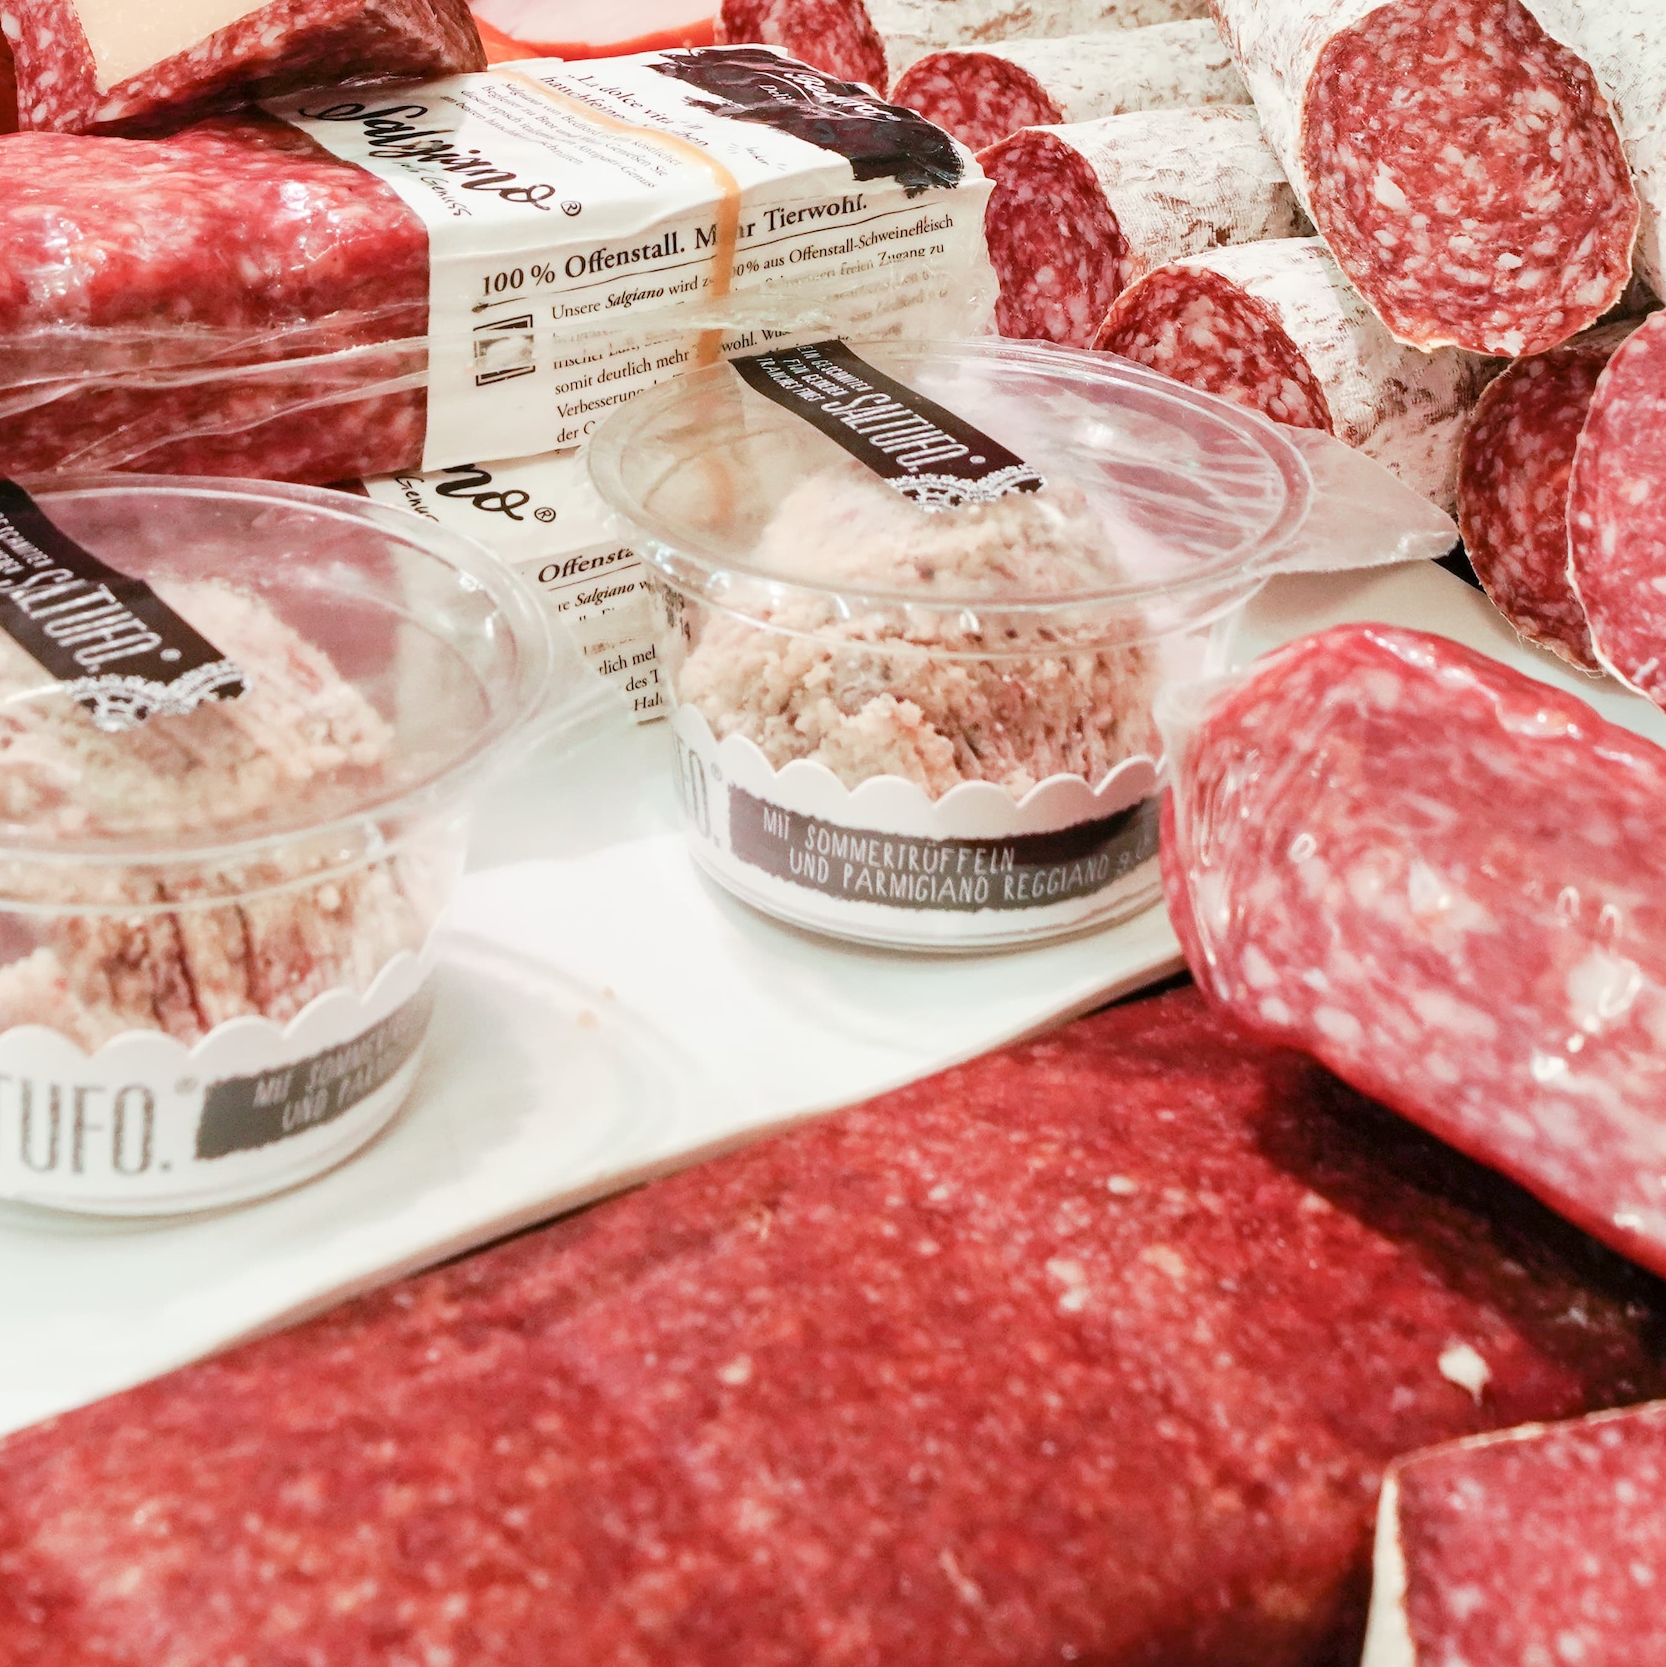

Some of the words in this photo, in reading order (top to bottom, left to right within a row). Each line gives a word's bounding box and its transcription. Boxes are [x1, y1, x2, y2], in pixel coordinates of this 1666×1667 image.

[483, 268, 524, 296] 100
[531, 263, 556, 286] %
[564, 231, 685, 279] Offenstall.
[763, 193, 867, 232] Tierwohl.
[551, 301, 601, 320] Unsere
[604, 284, 665, 310] Salgiano
[668, 275, 698, 296] wird
[763, 257, 785, 270] aus
[789, 213, 954, 265] Offenstall-Schweinefleisch
[554, 374, 593, 396] somit
[597, 357, 652, 384] deutlich
[656, 349, 690, 370] mehr
[556, 427, 579, 444] der
[537, 547, 635, 584] Offensta
[574, 581, 635, 607] Salgiano
[625, 675, 648, 692] des
[762, 806, 791, 841] MIT
[787, 845, 830, 885] UND
[841, 864, 990, 905] PARMIGIANO
[1002, 853, 1110, 902] REGGIANO
